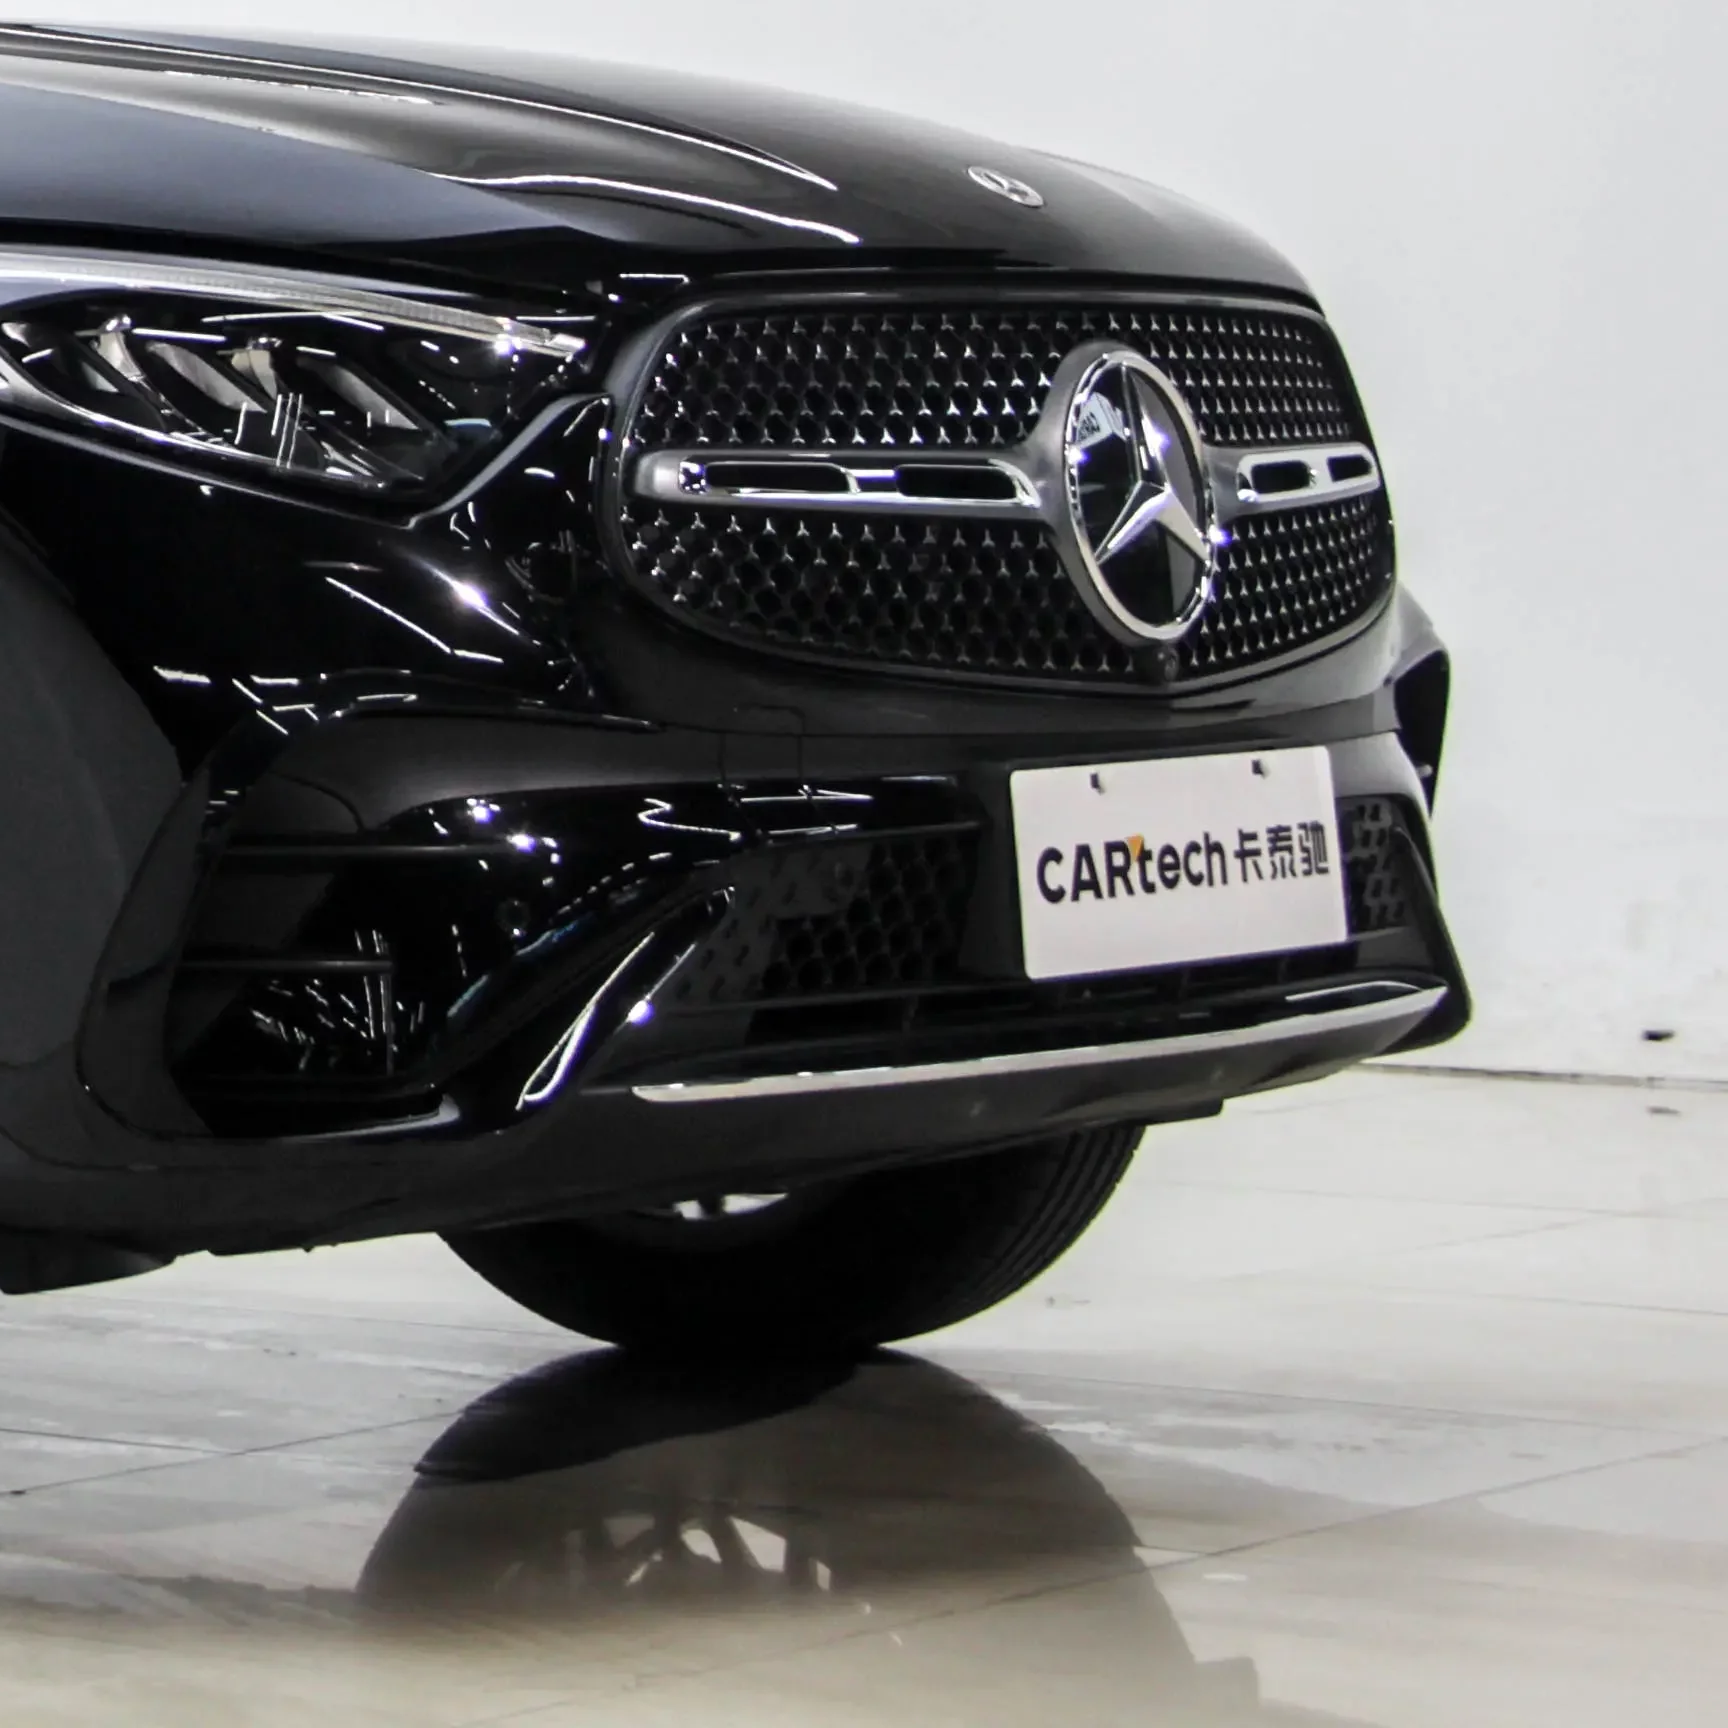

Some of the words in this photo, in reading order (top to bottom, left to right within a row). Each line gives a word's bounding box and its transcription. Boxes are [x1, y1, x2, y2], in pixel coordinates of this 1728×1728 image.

[1036, 832, 1228, 904] CARtech
[1233, 821, 1329, 882] 卡泰驰
